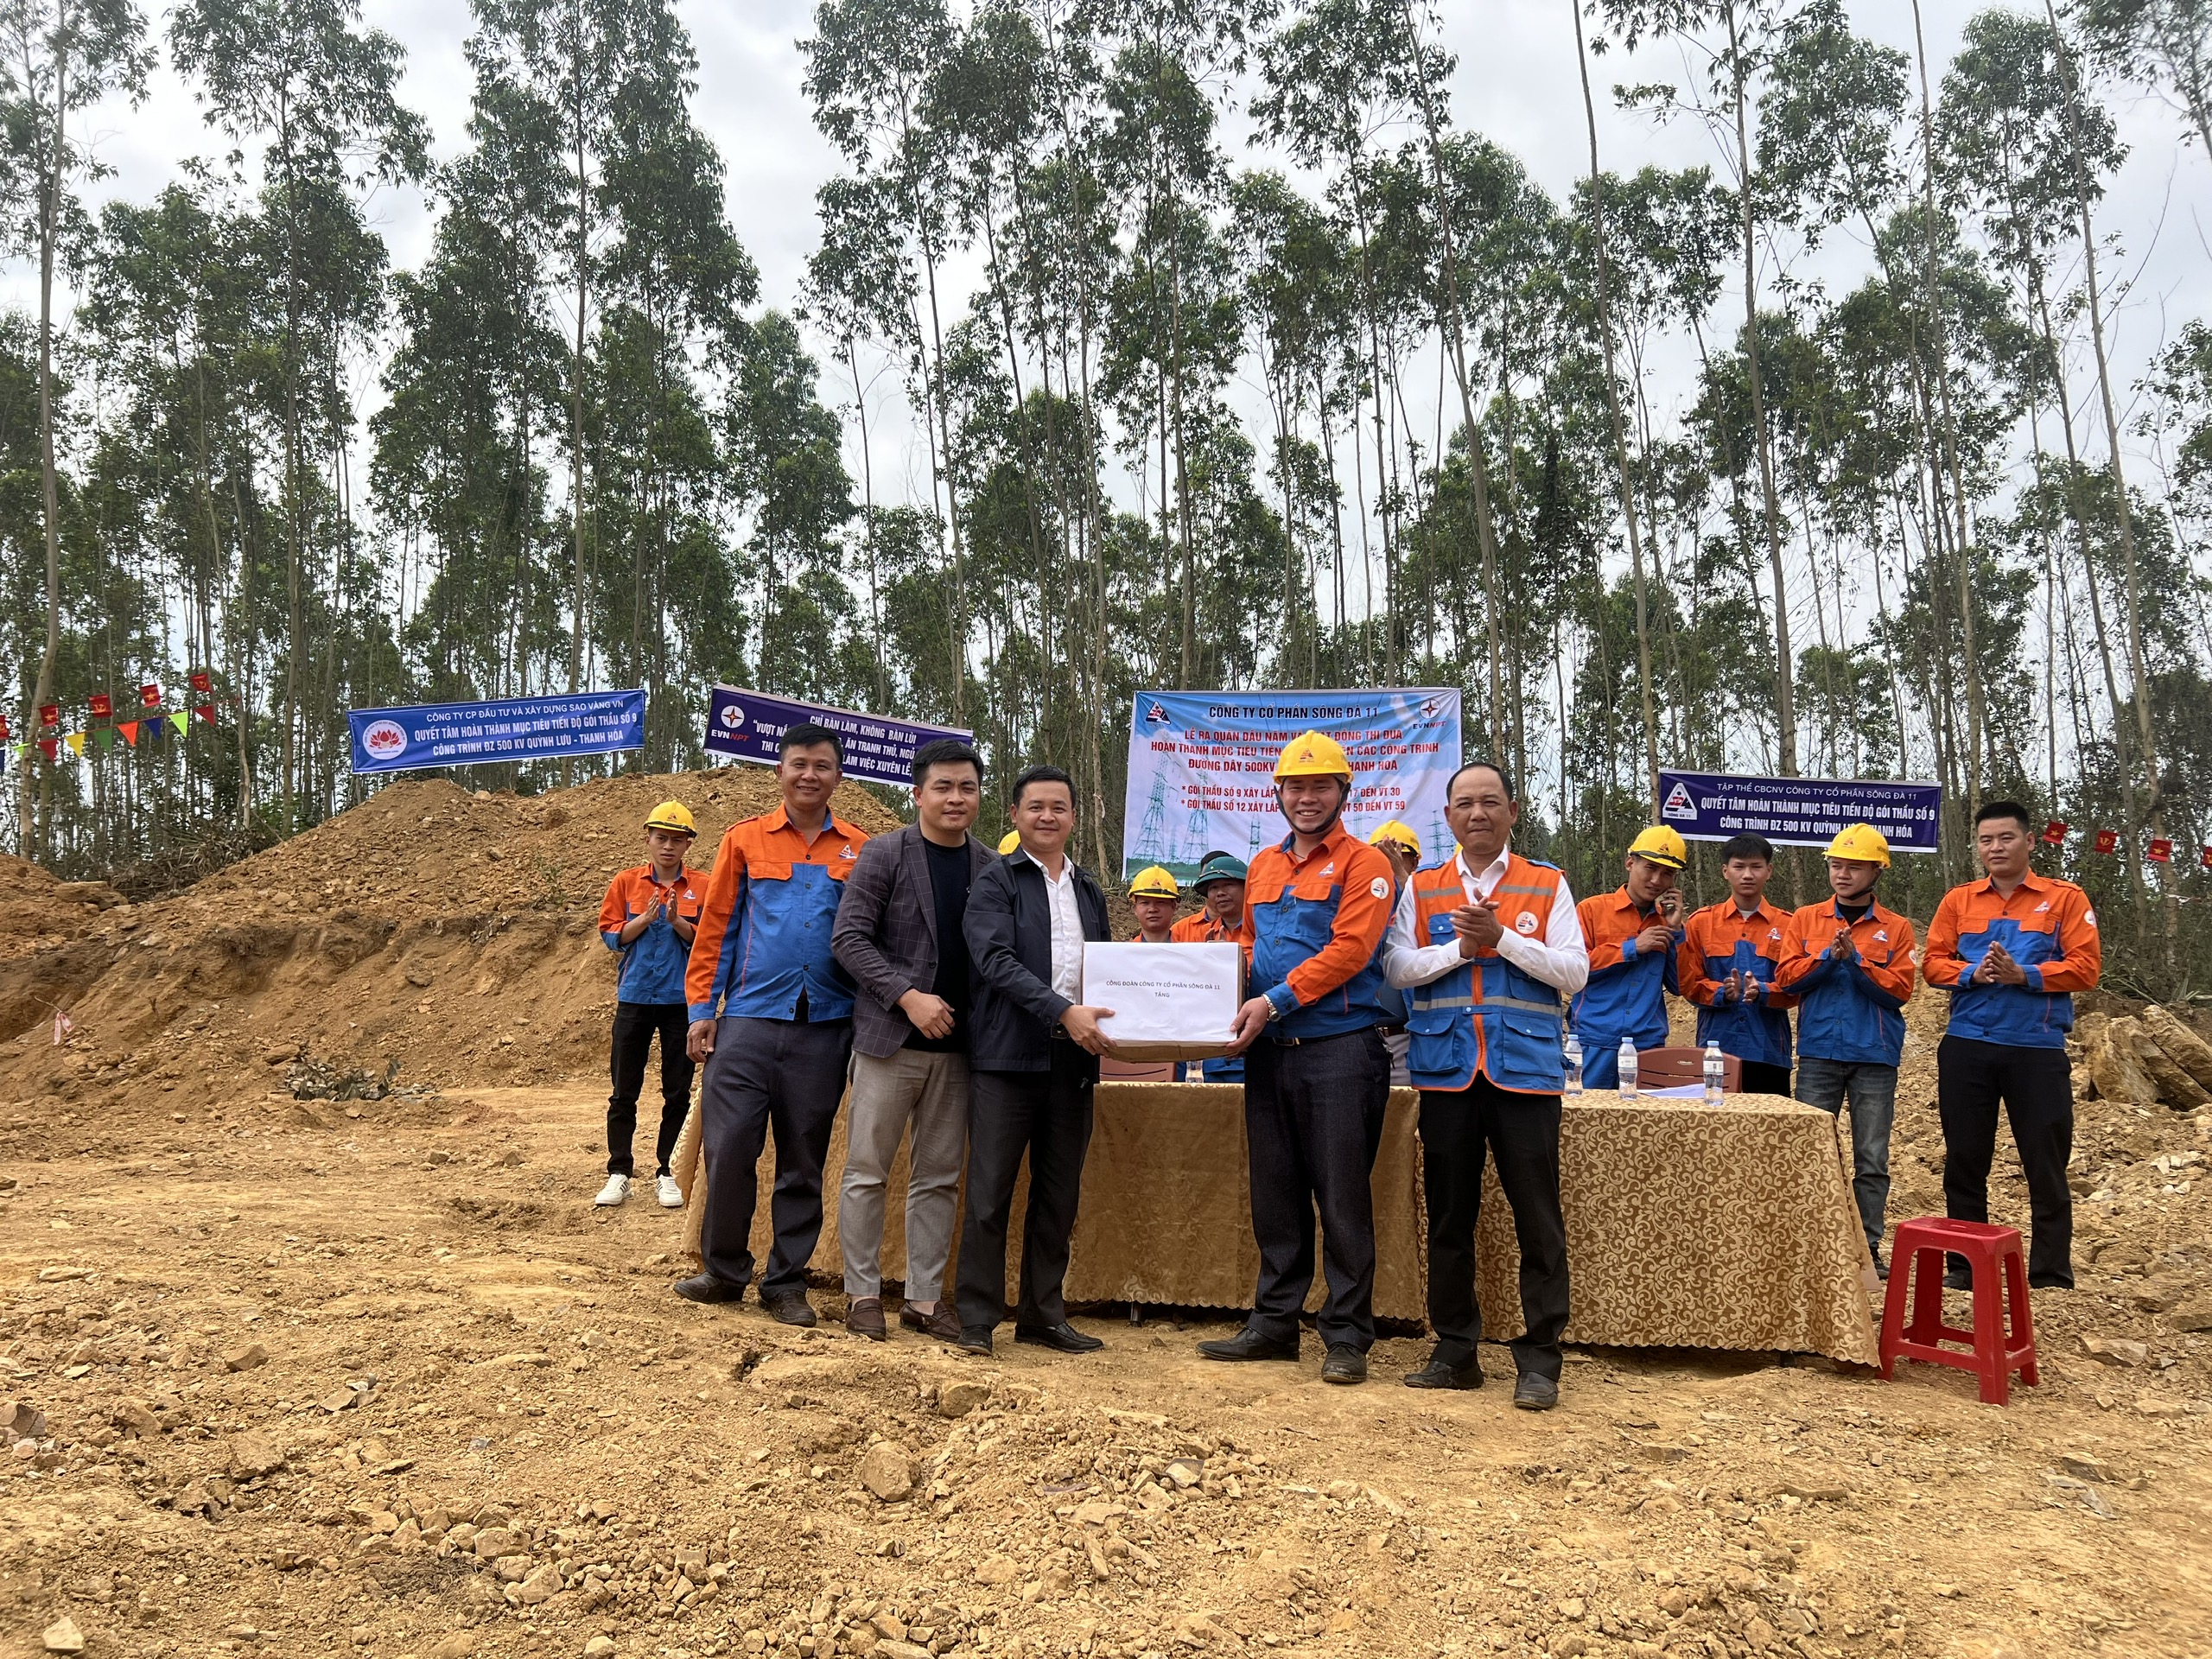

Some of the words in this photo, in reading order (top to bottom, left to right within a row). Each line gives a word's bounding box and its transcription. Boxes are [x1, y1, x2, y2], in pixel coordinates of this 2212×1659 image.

[426, 712, 451, 722] CÔNG
[453, 712, 464, 720] TY
[466, 711, 477, 719] CP
[479, 708, 497, 718] ĐẦU
[498, 708, 511, 717] TƯ
[512, 706, 523, 716] VÀ
[524, 705, 542, 715] XÂY
[543, 704, 567, 715] DỰNG
[569, 702, 586, 712] SAO
[588, 699, 611, 710] VÀNG
[612, 700, 624, 708] VN
[1210, 704, 1239, 718] CÔNG
[1243, 707, 1256, 718] TY
[1259, 702, 1274, 718] CỔ
[1277, 704, 1308, 718] PHẦN
[1312, 704, 1343, 718] SÔNG
[1346, 704, 1362, 718] ĐÀ
[1366, 707, 1378, 718] 11
[415, 725, 440, 743] QUYẾT
[442, 725, 460, 739] TÂM
[461, 723, 483, 737] HOÀN
[484, 720, 511, 735] THÀNH
[513, 721, 531, 735] MỤC
[532, 718, 550, 731] TIÊU
[552, 715, 569, 730] TIẾN
[570, 715, 581, 730] ĐỘ
[584, 715, 597, 727] GÓI
[598, 712, 619, 726] THẦU
[620, 709, 631, 725] SỐ
[632, 712, 637, 723] 9
[809, 714, 823, 727] CHỈ
[823, 717, 840, 730] BÀN
[840, 720, 858, 735] LÀM,
[860, 724, 885, 739] KHÔNG
[888, 730, 904, 742] BÀN
[904, 732, 917, 744] LÙI
[1413, 721, 1446, 730] EVNNPT
[433, 743, 456, 756] CÔNG
[458, 740, 482, 754] TRÌNH
[483, 740, 496, 752] ĐZ
[496, 740, 512, 751] 500
[514, 738, 525, 750] KV
[527, 735, 554, 749] QUỲNH
[556, 734, 572, 746] LƯU
[579, 734, 606, 744] THANH
[607, 728, 624, 742] HÓA
[711, 729, 750, 742] EVNNPT
[1199, 731, 1211, 741] RA
[1214, 729, 1240, 741] QUÂN
[1243, 729, 1262, 742] ĐẦU
[1265, 730, 1287, 742] NĂM
[1334, 729, 1362, 744] ĐỘNG
[1365, 730, 1380, 741] THI
[1383, 730, 1402, 740] ĐUA
[762, 741, 774, 752] THI
[859, 756, 875, 772] VIỆC
[876, 760, 901, 773] XUYÊN
[845, 737, 857, 750] ĂN
[858, 741, 881, 753] TRANH
[883, 742, 898, 759] THỦ,
[899, 747, 916, 760] NGỦ
[1151, 741, 1176, 753] HOÀN
[1179, 743, 1209, 755] THÀNH
[1211, 746, 1234, 758] MỤC
[1236, 745, 1257, 756] TIÊU
[1260, 744, 1281, 756] TIẾN
[1357, 744, 1377, 756] CÁC
[1380, 744, 1407, 755] CÔNG
[1410, 742, 1439, 753] TRÌNH
[1189, 758, 1220, 771] ĐƯỜNG
[1224, 760, 1242, 772] DÂY
[1245, 762, 1275, 772] 500KV
[1348, 760, 1375, 772] HANH
[1188, 785, 1200, 795] GÓI
[1202, 784, 1222, 796] THẦU
[1224, 786, 1234, 797] SỐ
[1244, 787, 1259, 798] XÂY
[1360, 785, 1376, 797] ĐẾN
[1379, 788, 1388, 796] VT
[1390, 787, 1400, 796] 30
[1717, 783, 1734, 792] TẬP
[1736, 782, 1752, 792] THỂ
[1754, 785, 1784, 795] CBCNV
[1786, 784, 1811, 795] CÔNG
[1826, 786, 1839, 797] CỔ
[1840, 788, 1864, 798] PHẦN
[1866, 789, 1891, 799] SÔNG
[1894, 791, 1905, 800] ĐÀ
[1187, 799, 1200, 809] GÓI
[1202, 798, 1221, 810] THẦU
[1224, 798, 1234, 810] SỐ
[1236, 803, 1245, 811] 12
[1248, 801, 1263, 812] XÂY
[1354, 803, 1363, 811] 50
[1366, 799, 1381, 811] ĐẾN
[1384, 802, 1392, 810] VT
[1395, 801, 1405, 810] 59
[1701, 795, 1727, 810] QUYẾT
[1728, 798, 1746, 811] TÂM
[1748, 797, 1770, 812] HOÀN
[1772, 798, 1799, 814] THÀNH
[1801, 803, 1821, 817] MỤC
[1822, 801, 1840, 816] TIÊU
[1842, 801, 1862, 817] TIẾN
[1862, 803, 1874, 820] ĐỘ
[1876, 804, 1890, 818] GÓI
[1892, 804, 1913, 820] THẦU
[1916, 805, 1927, 820] SỐ
[1929, 810, 1935, 820] 9
[1720, 817, 1742, 830] CÔNG
[1744, 817, 1769, 830] TRÌNH
[1770, 820, 1782, 831] ĐZ
[1783, 821, 1798, 833] 500
[1800, 822, 1812, 833] KV
[1813, 820, 1841, 834] QUỲNH
[1896, 824, 1913, 838] HÓA
